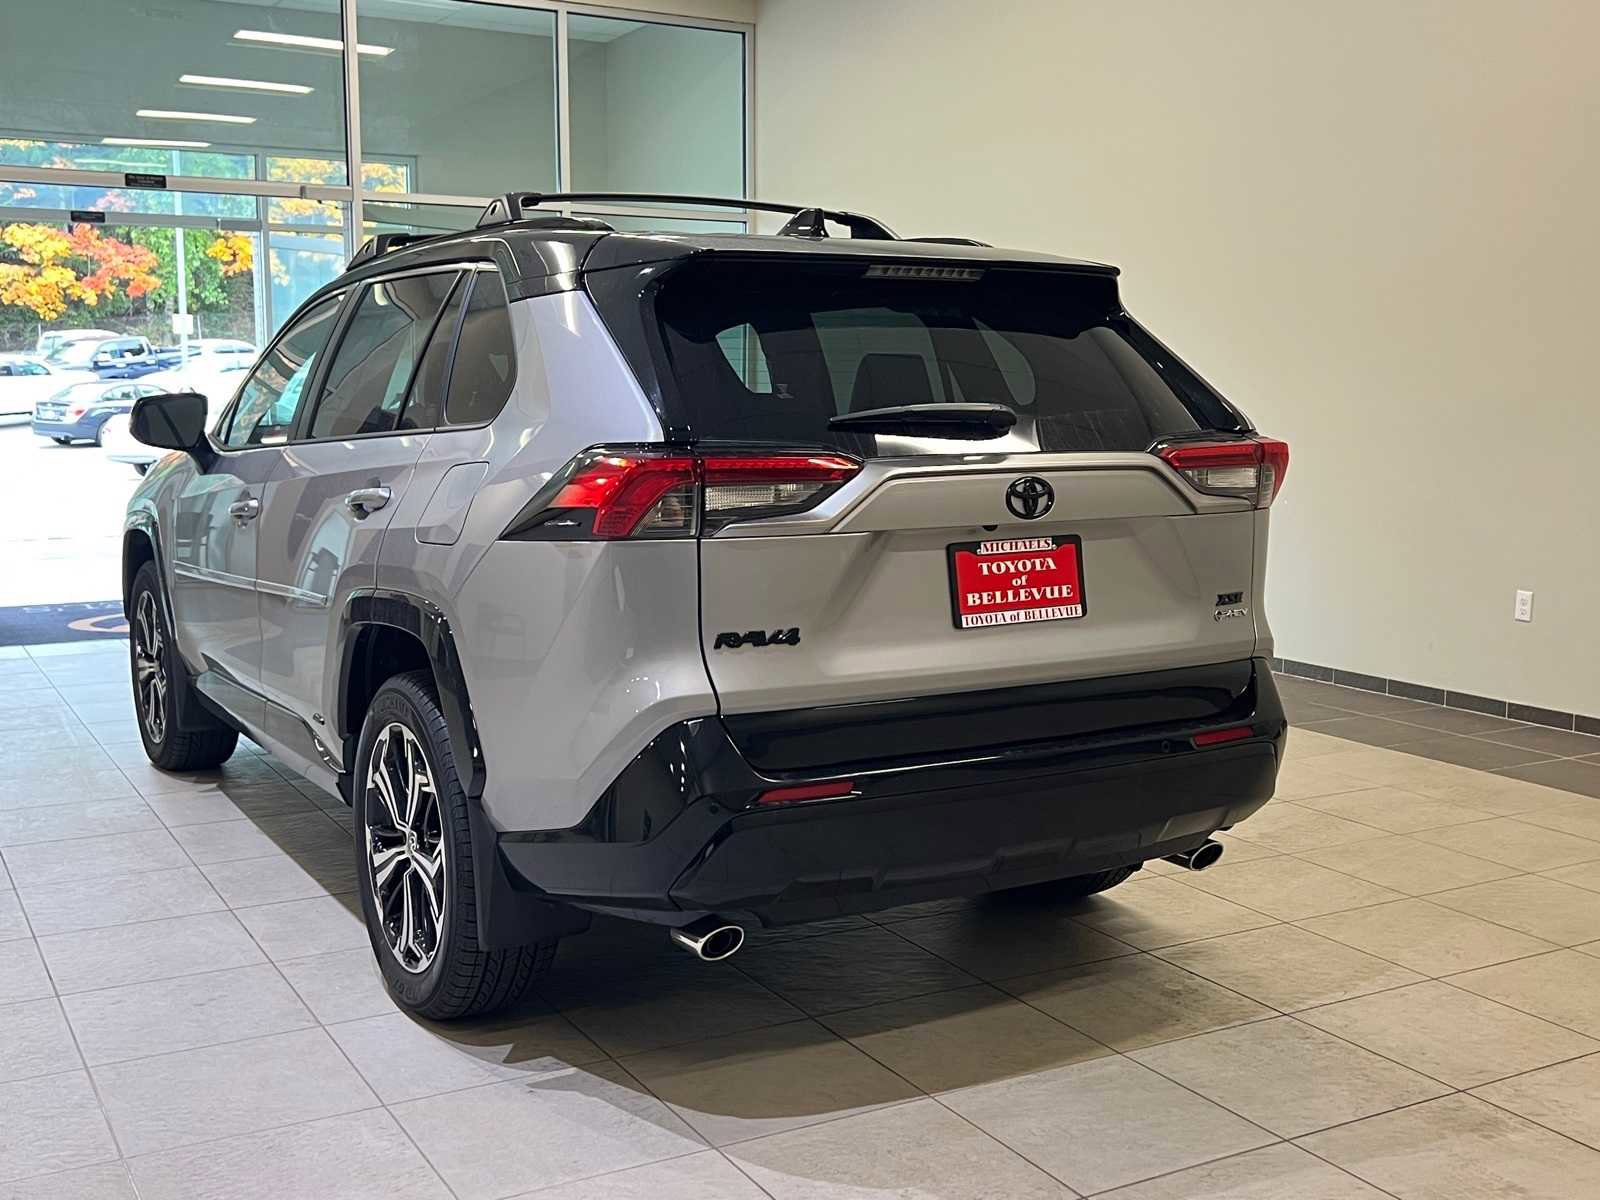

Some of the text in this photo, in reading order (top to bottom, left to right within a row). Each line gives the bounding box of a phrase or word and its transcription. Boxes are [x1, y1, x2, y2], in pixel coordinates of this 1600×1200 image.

[982, 538, 1051, 553] MICHAELS
[978, 557, 1056, 576] TOYOTA
[1012, 575, 1028, 586] of
[966, 584, 1074, 606] BELLEVUE
[963, 605, 1081, 627] TOYOTA of BELLEVUE
[713, 627, 801, 650] RAV4
